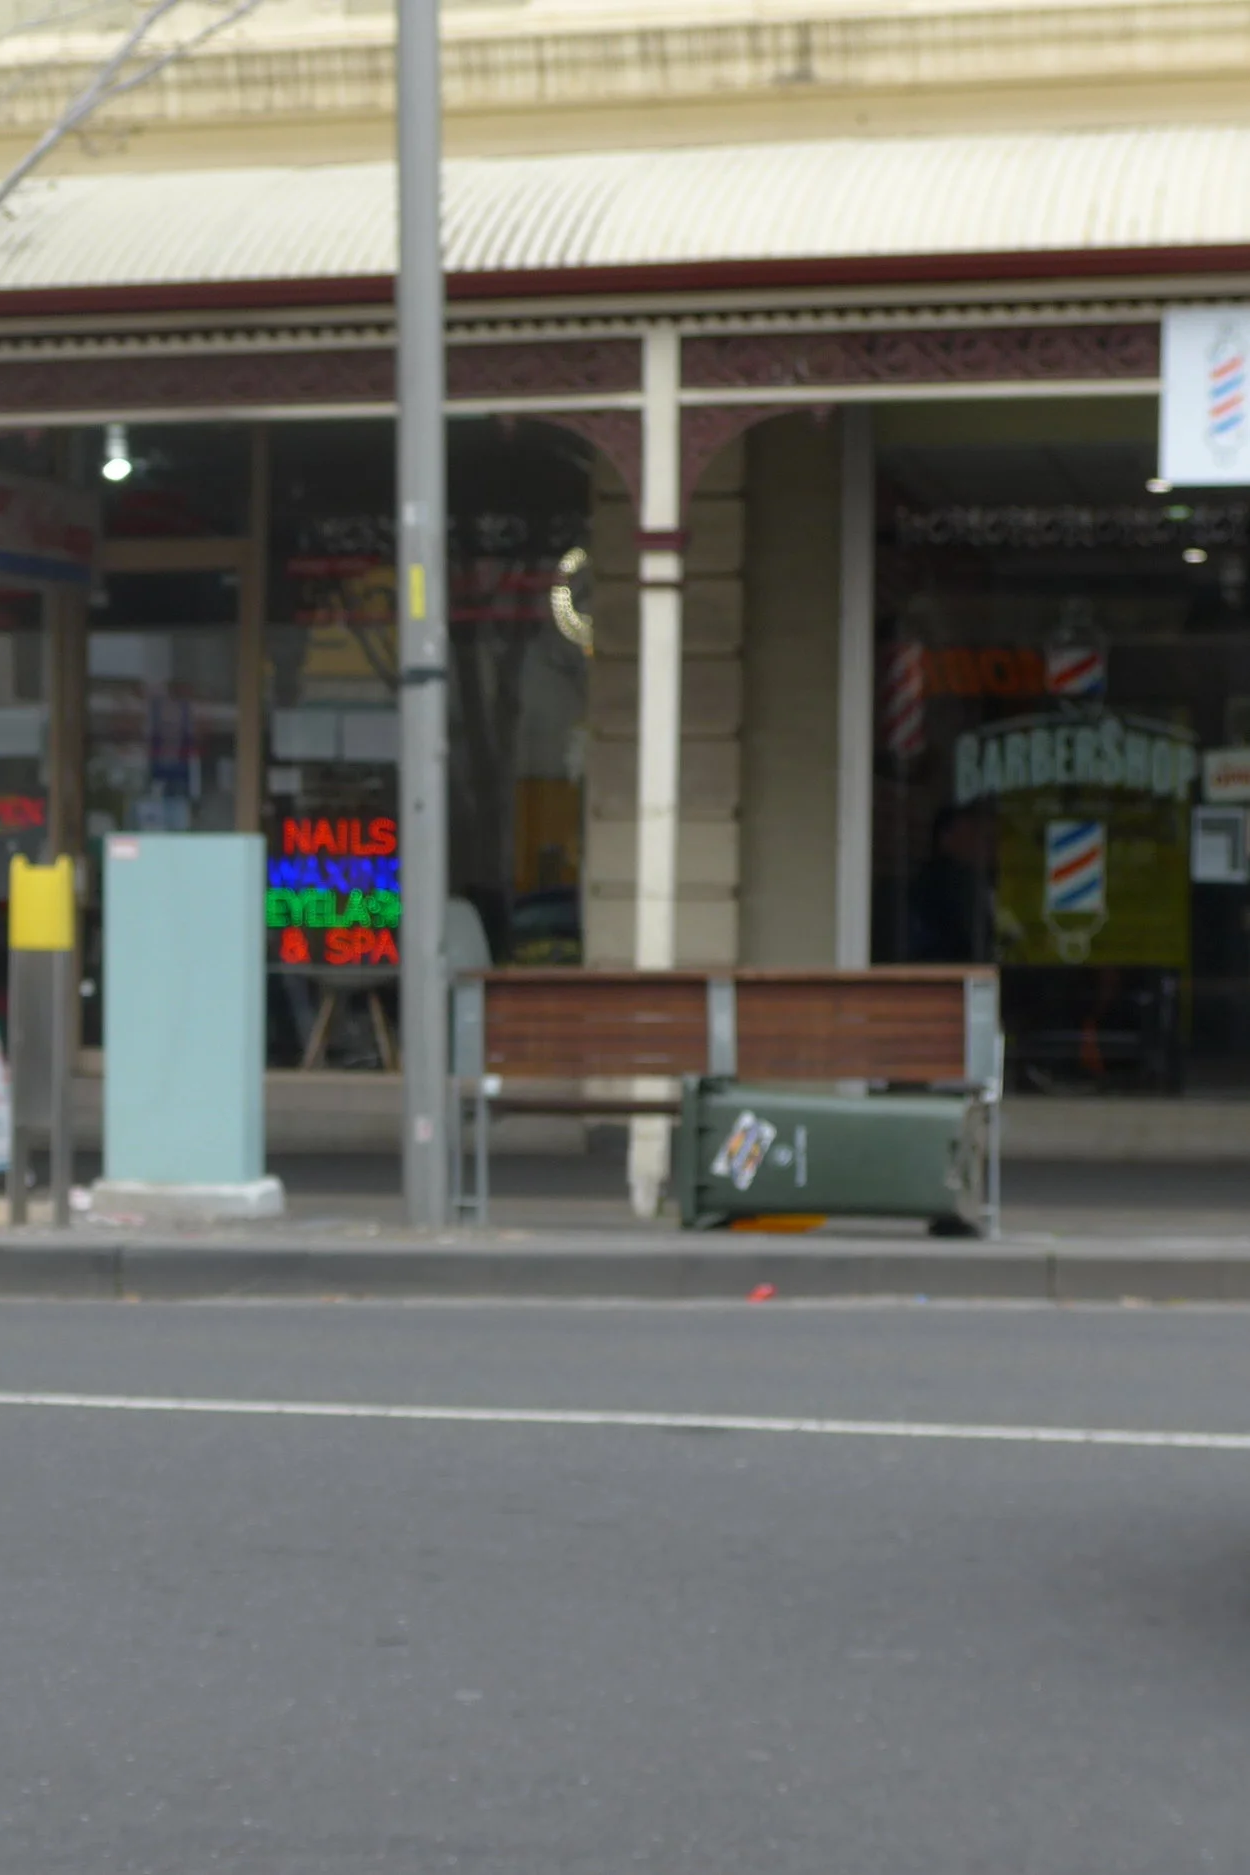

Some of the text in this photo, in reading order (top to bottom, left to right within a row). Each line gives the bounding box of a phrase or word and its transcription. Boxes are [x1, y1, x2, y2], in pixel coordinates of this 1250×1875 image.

[284, 817, 398, 856] NAILS
[280, 925, 400, 966] & SPA
